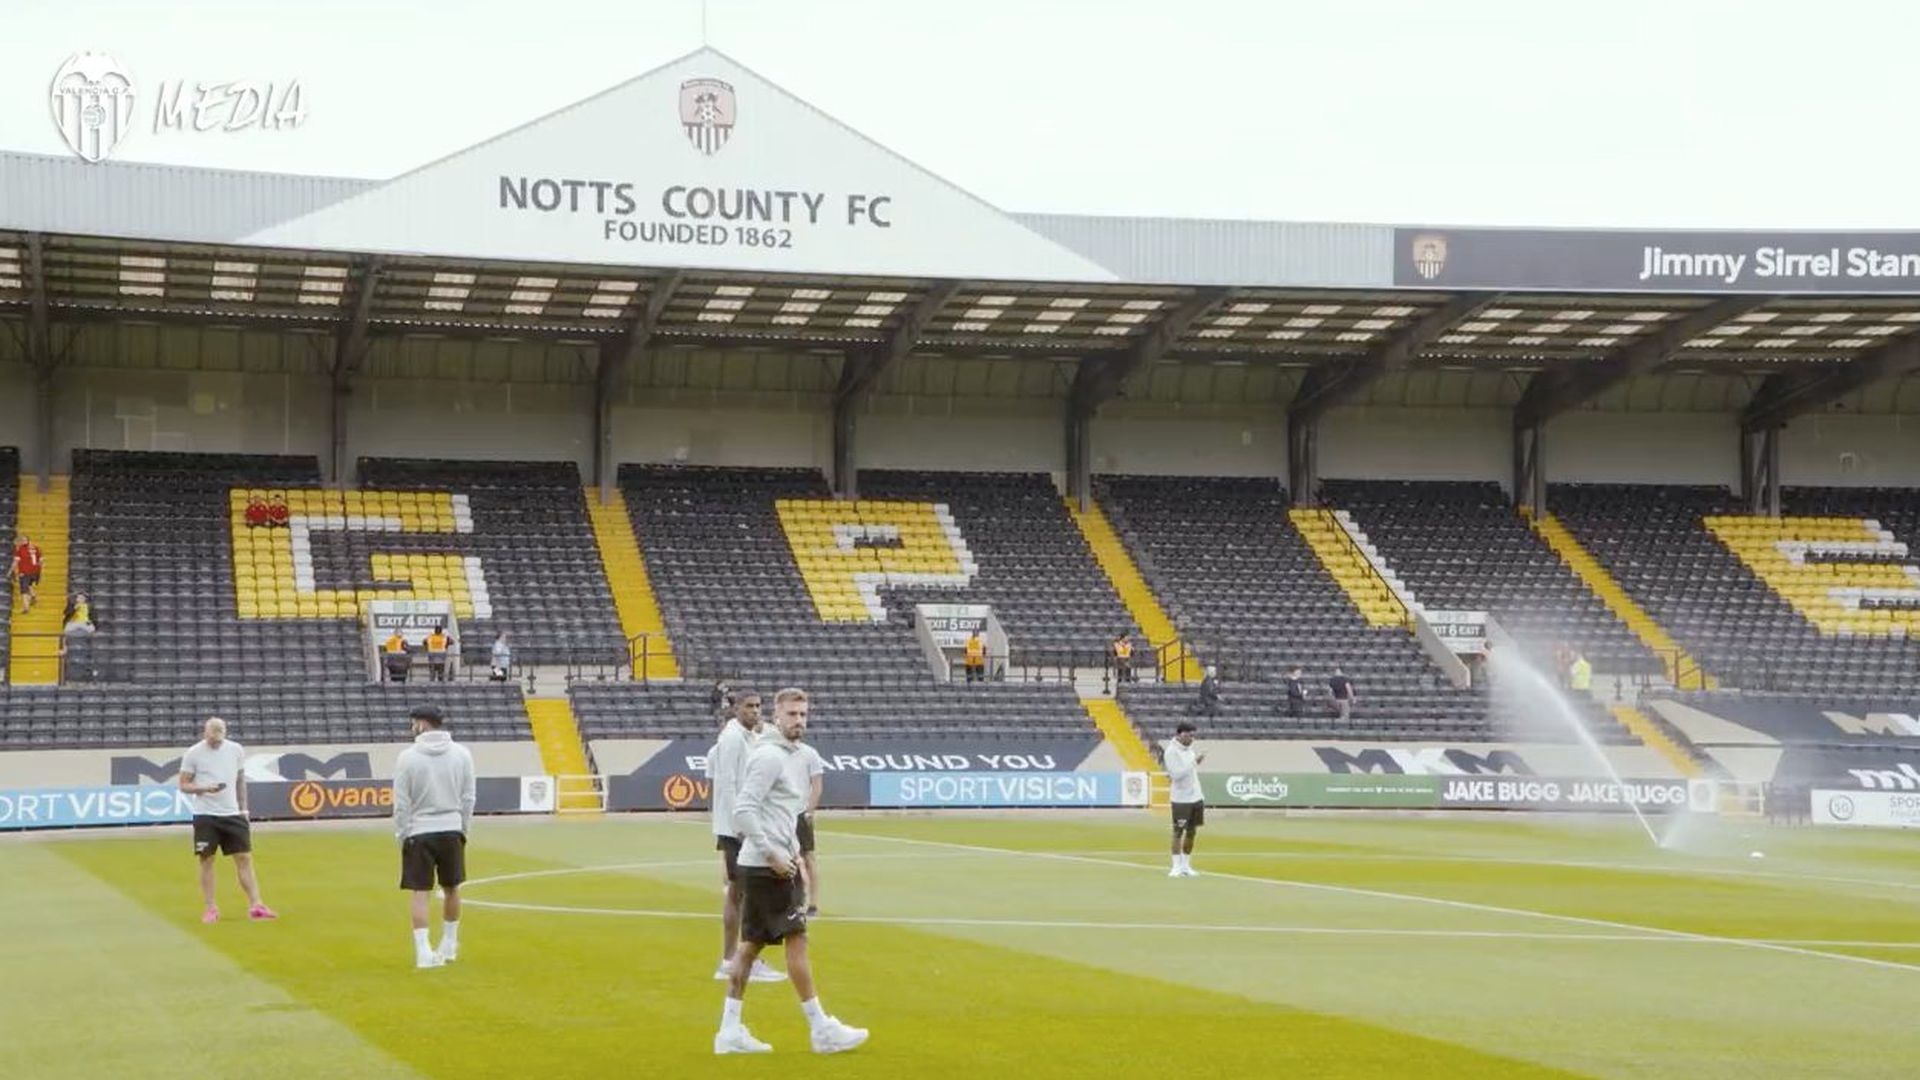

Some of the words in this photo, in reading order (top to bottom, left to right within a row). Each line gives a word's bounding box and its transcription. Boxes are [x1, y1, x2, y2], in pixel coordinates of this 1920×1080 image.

[499, 176, 636, 215] NOTTS
[662, 185, 825, 223] COUNTY
[847, 194, 892, 228] FC
[604, 220, 728, 246] FOUNDED
[735, 226, 793, 249] 1862
[1640, 245, 1747, 283] Jimmy
[1755, 246, 1840, 277] Sirrel
[378, 615, 404, 627] EXIT
[405, 614, 416, 627] 4
[416, 615, 442, 627] EXIT
[1448, 624, 1457, 636] 6
[977, 754, 1056, 769] YOU
[1226, 775, 1289, 801] Carlsberg
[1443, 781, 1494, 801] JAKE
[1499, 782, 1561, 802] BUGG
[1567, 784, 1619, 803] JAKE
[1623, 785, 1687, 805] BUGG
